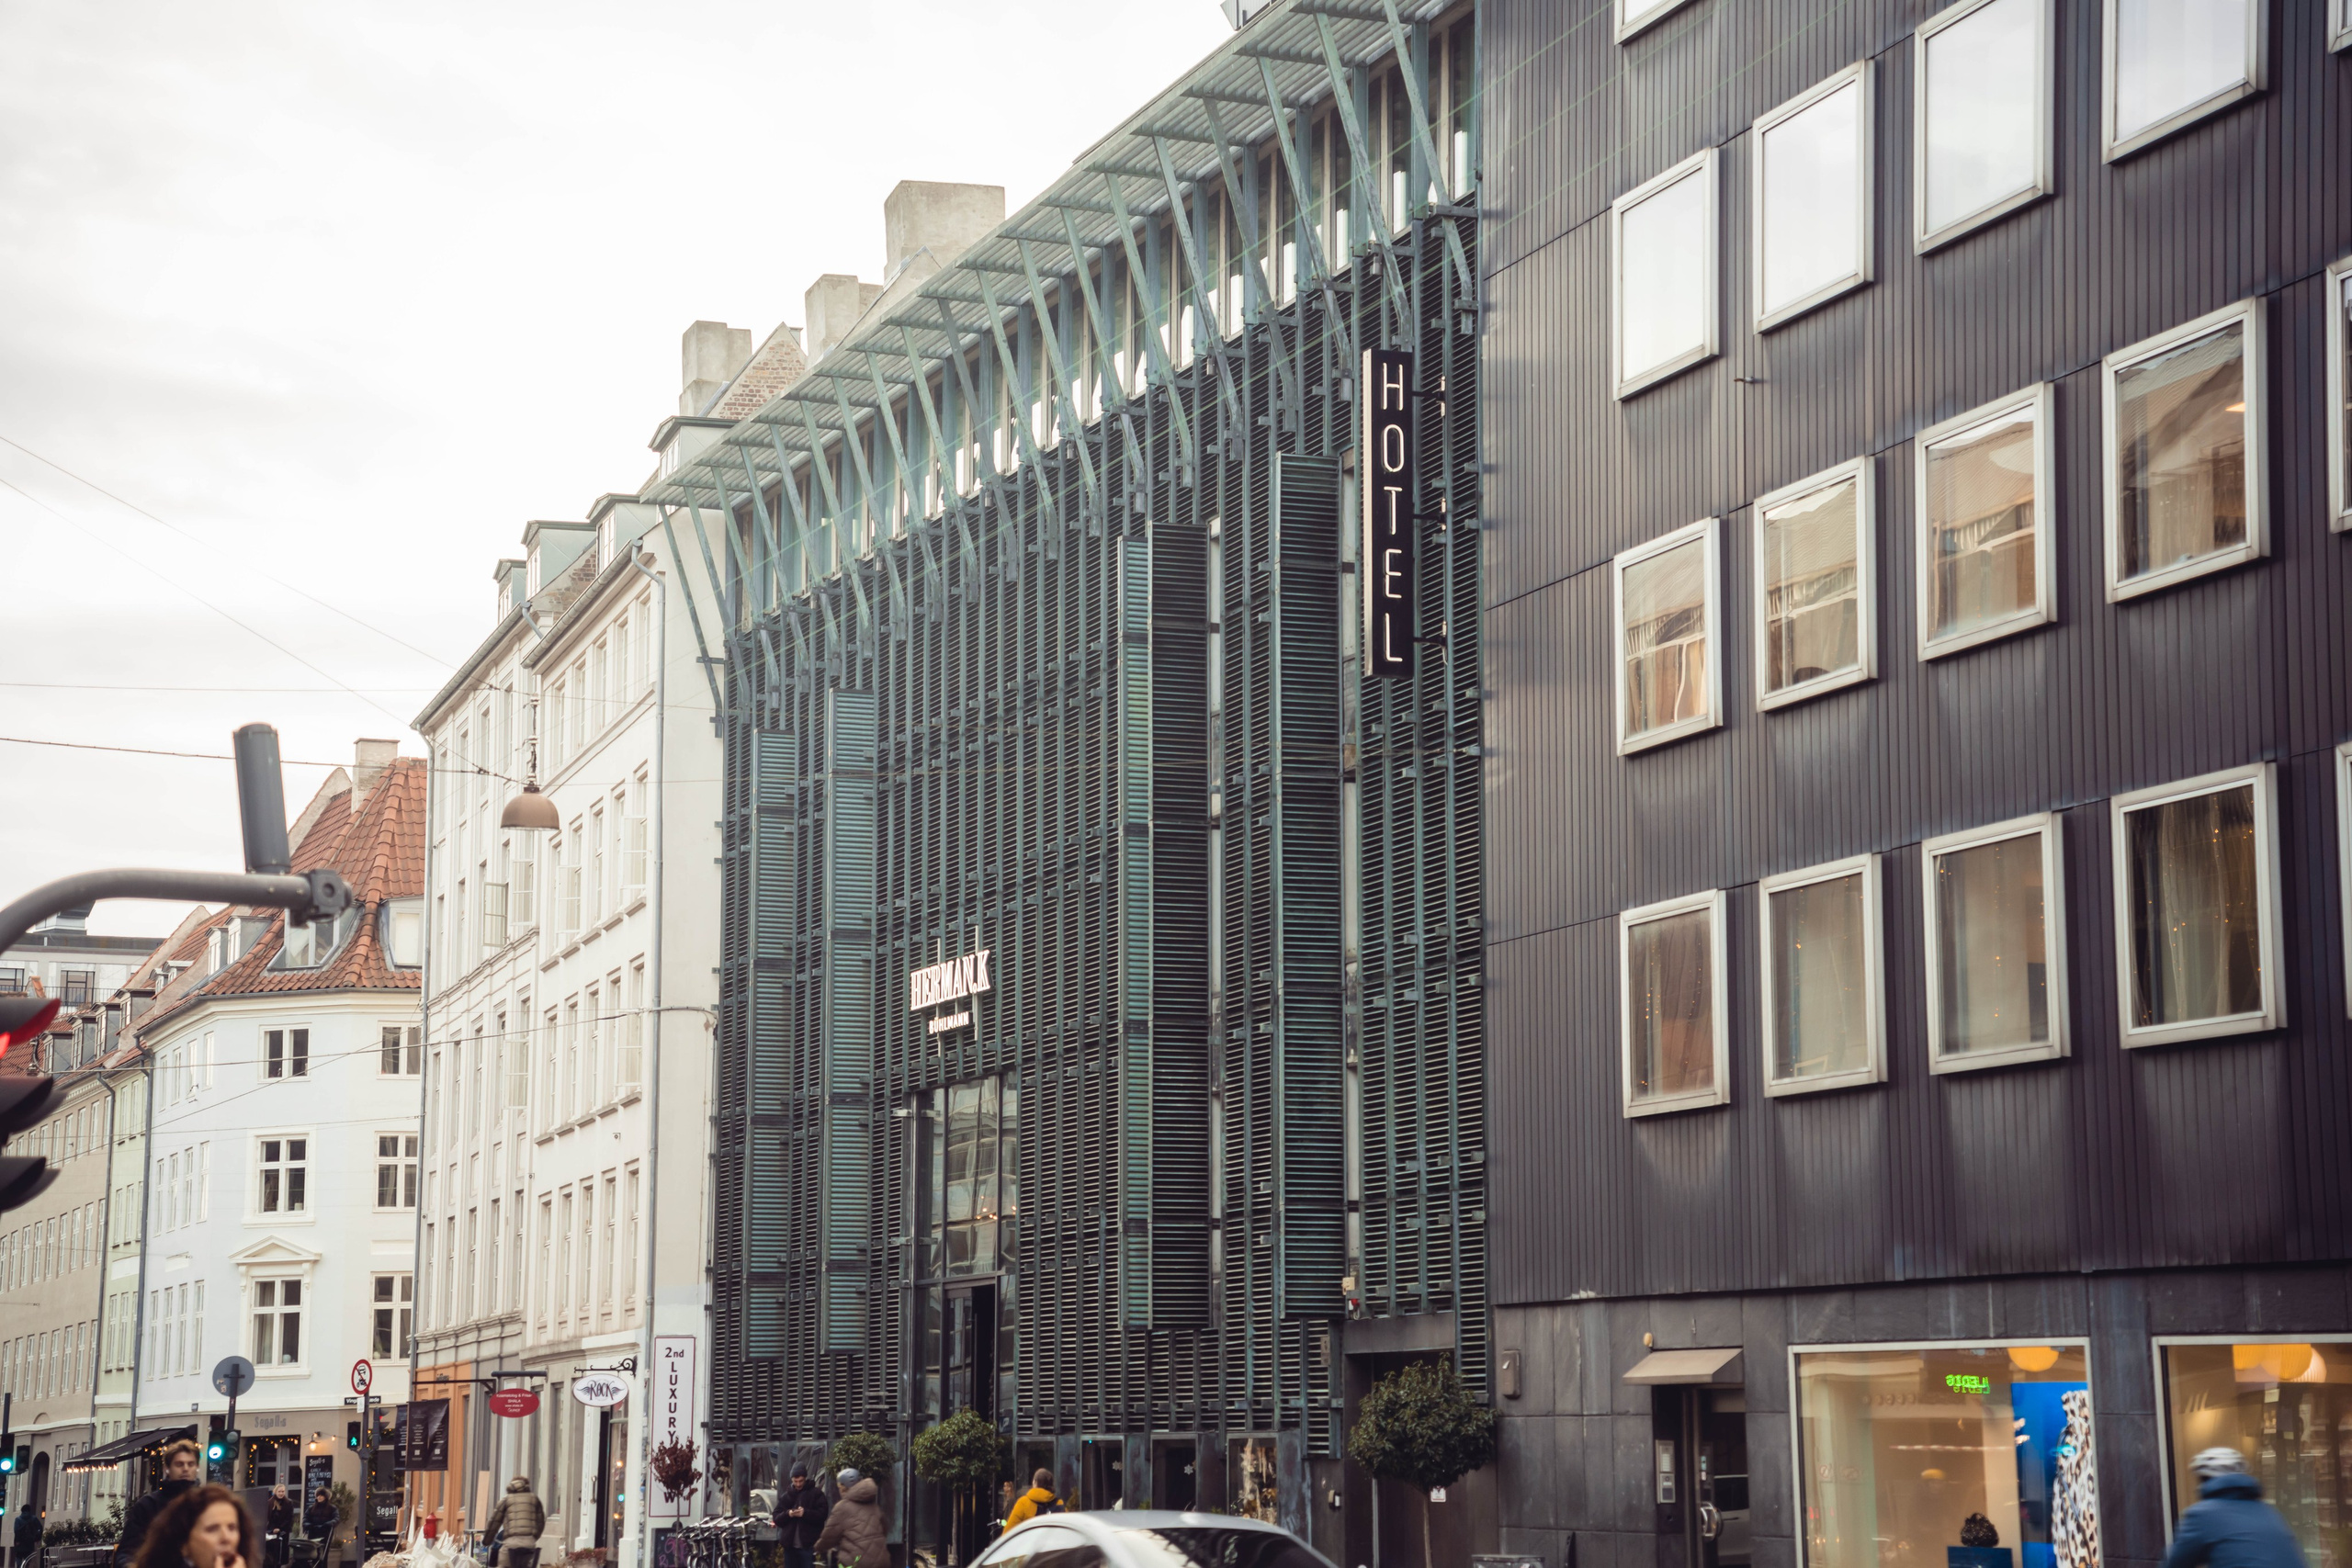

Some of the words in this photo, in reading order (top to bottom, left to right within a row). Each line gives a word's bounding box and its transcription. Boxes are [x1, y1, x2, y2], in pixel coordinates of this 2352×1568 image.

[1382, 362, 1405, 662] HOTEL
[929, 1011, 969, 1034] BÜHLMANN
[665, 1347, 684, 1359] 2nd
[668, 1361, 678, 1446] LUXURY
